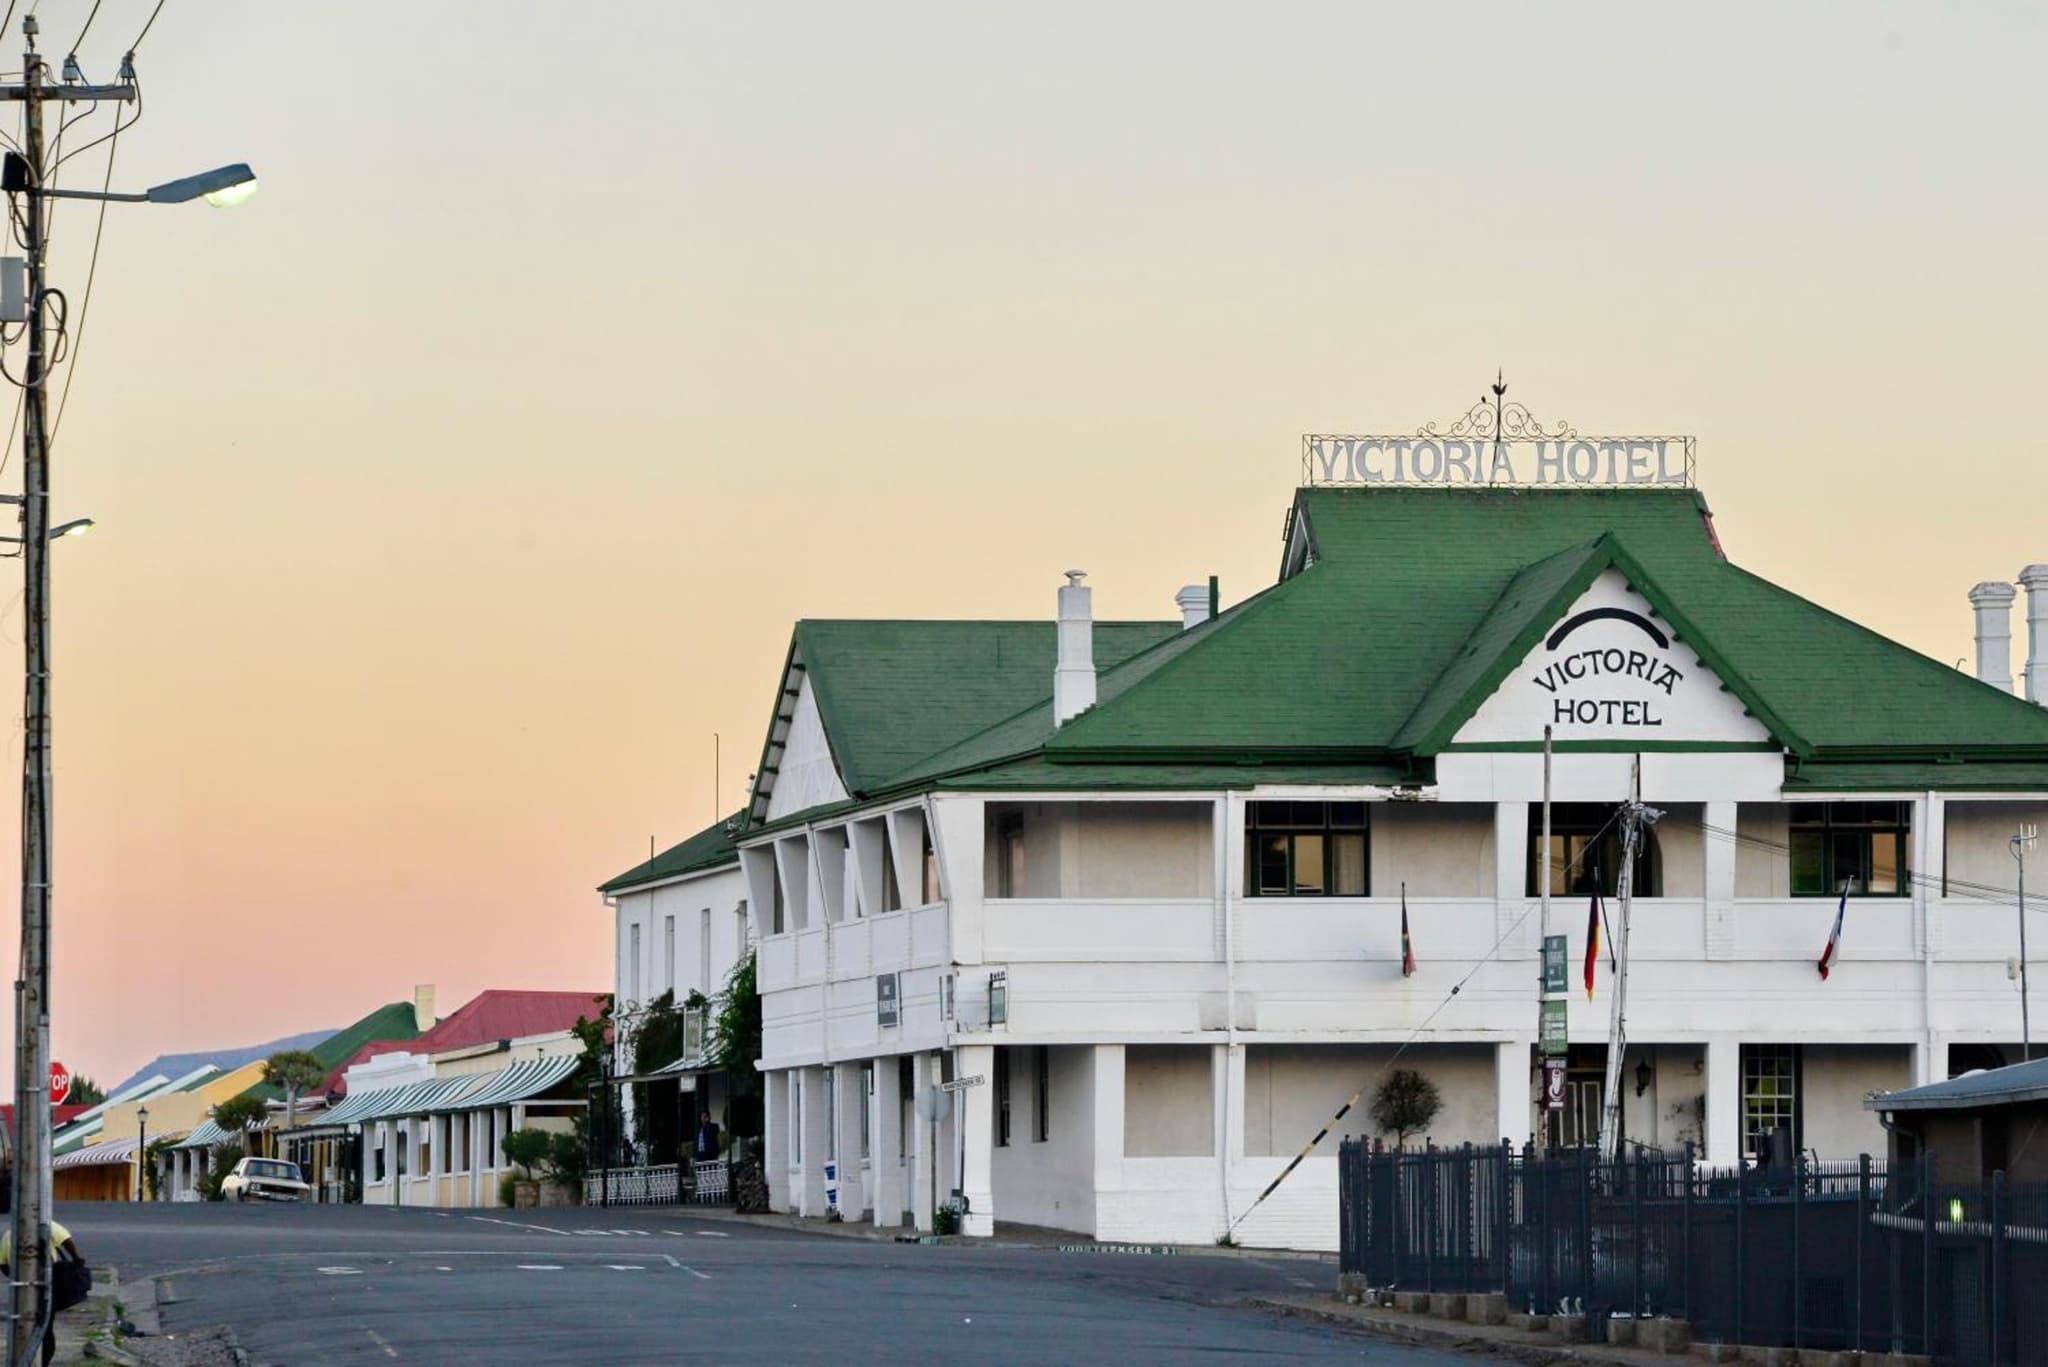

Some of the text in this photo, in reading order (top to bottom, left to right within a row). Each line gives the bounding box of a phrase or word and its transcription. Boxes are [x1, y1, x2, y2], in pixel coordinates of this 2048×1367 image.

[1312, 440, 1685, 484] VICTORIA HOTEL
[1533, 648, 1684, 695] VICTORIA
[1554, 699, 1662, 726] HOTEL
[49, 1074, 68, 1090] OP
